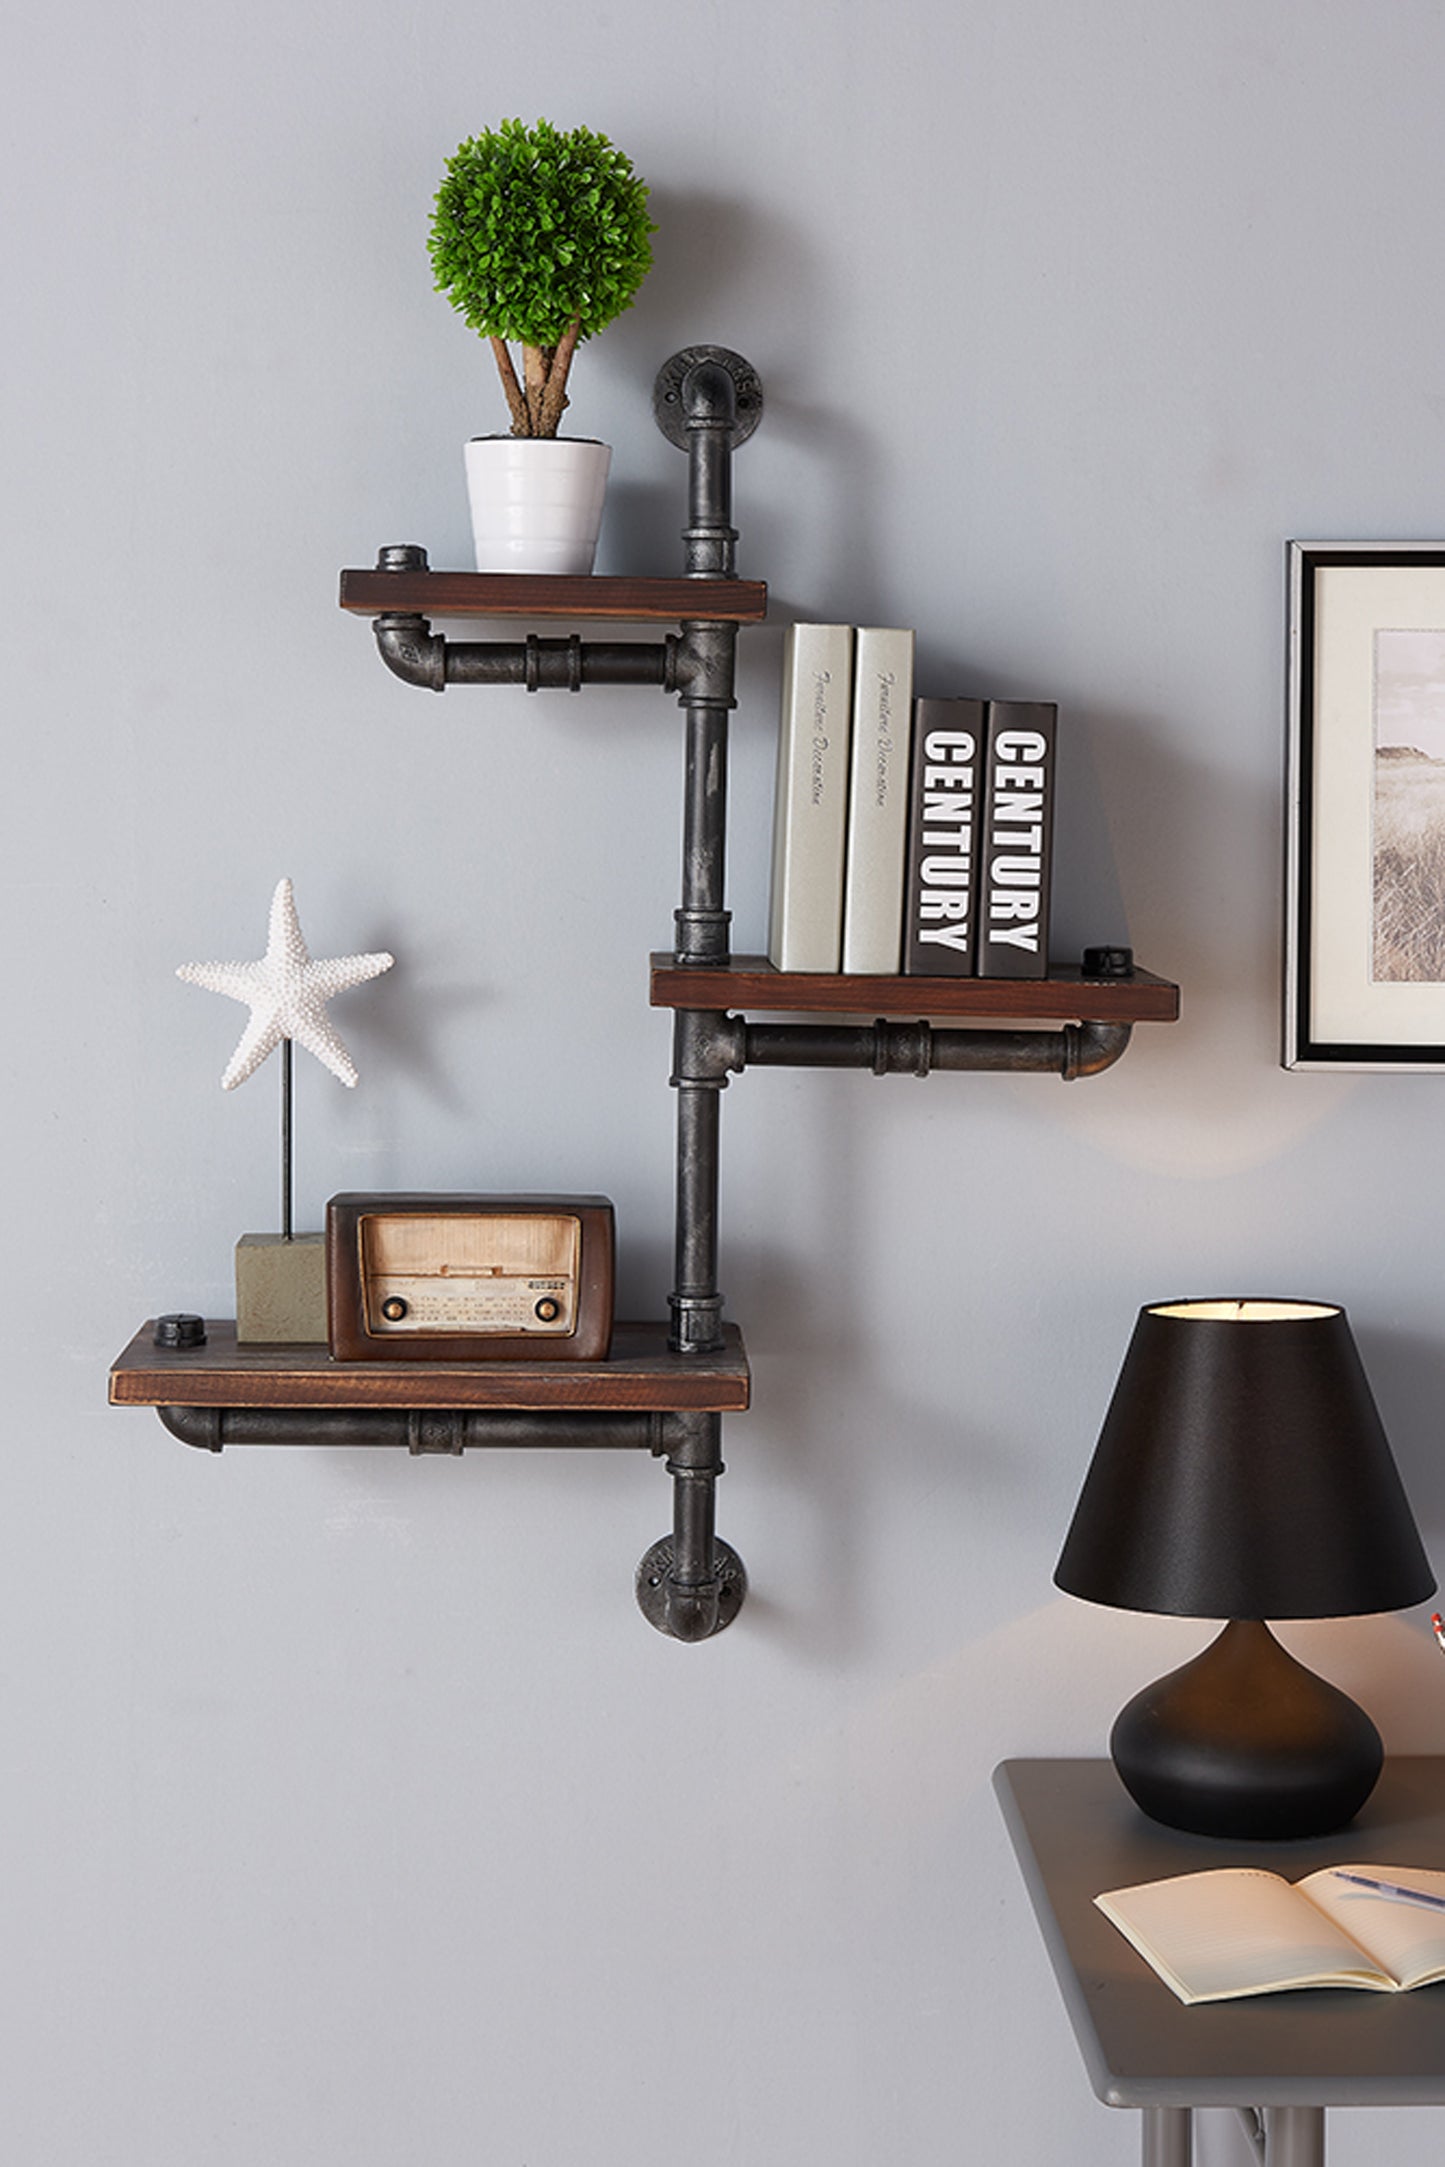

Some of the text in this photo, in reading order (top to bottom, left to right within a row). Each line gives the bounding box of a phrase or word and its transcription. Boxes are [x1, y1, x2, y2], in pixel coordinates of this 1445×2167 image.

[811, 670, 831, 806] Furniture Decoration
[875, 672, 896, 807] Furniture Decoration
[919, 731, 975, 952] CENTURY
[989, 731, 1047, 952] CENTURY
